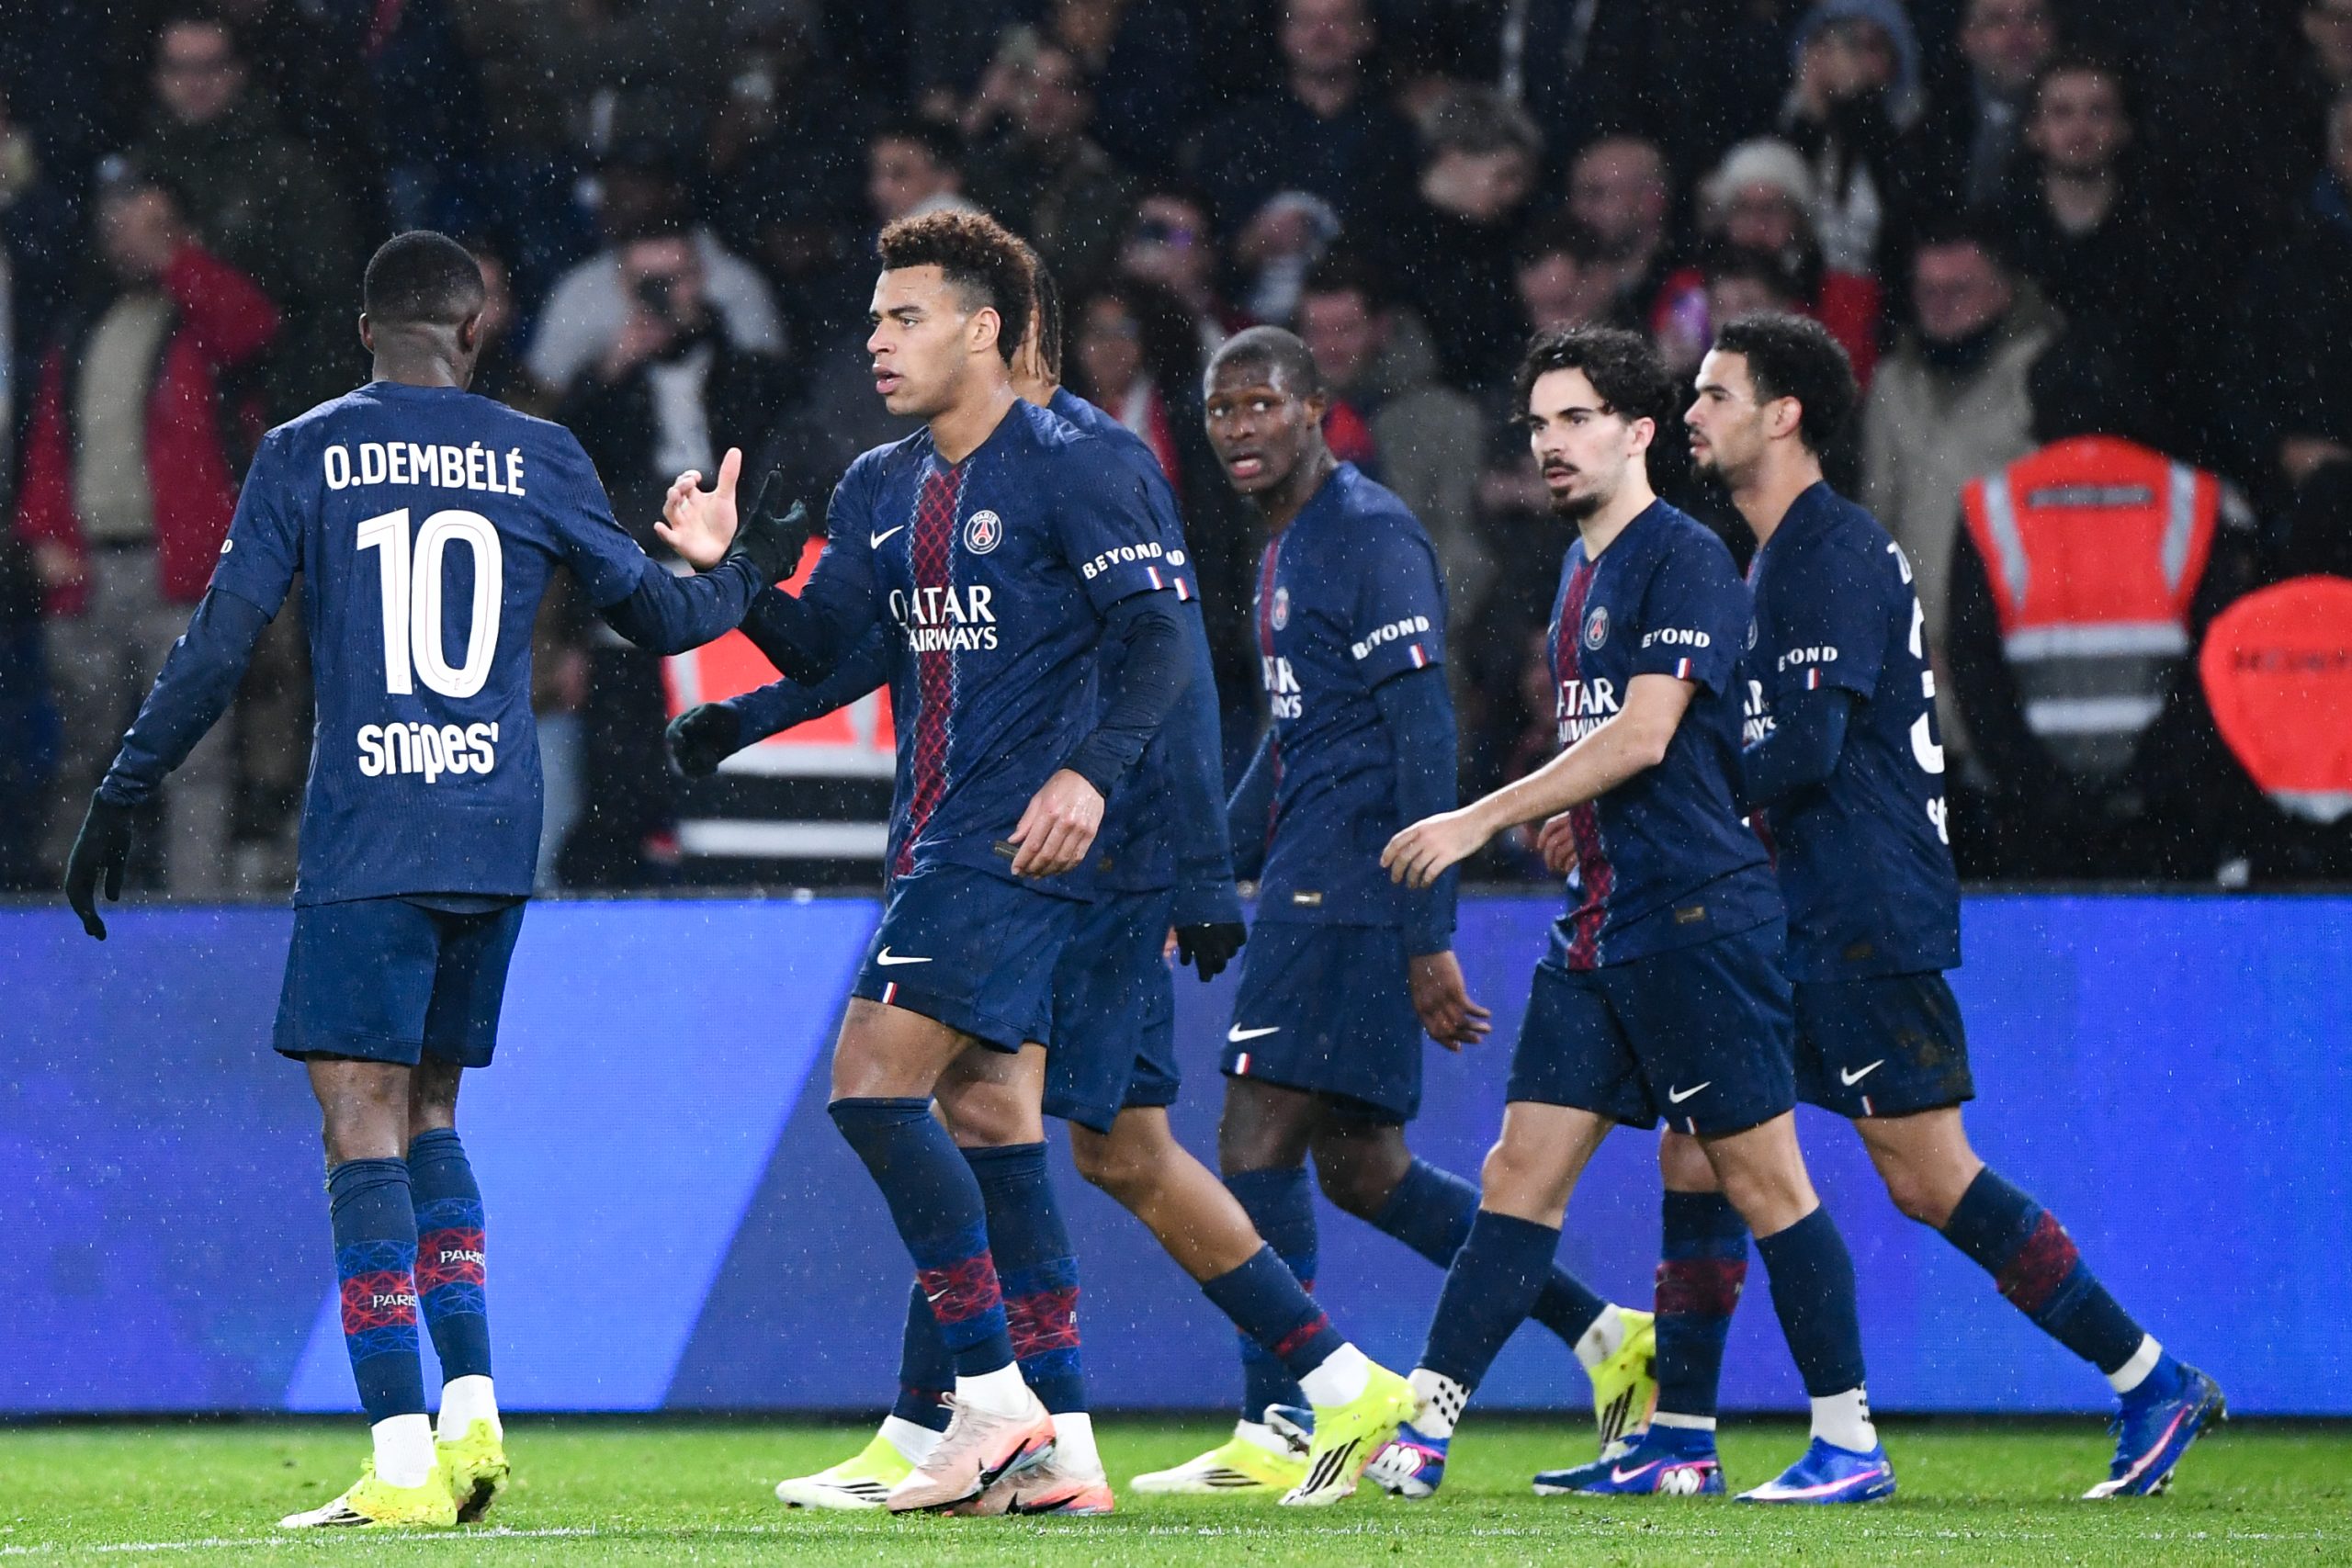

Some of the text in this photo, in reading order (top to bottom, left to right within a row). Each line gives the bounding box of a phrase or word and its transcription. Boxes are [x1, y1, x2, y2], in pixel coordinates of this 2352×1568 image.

[324, 441, 526, 496] O.DEMBÉLÉ
[1082, 541, 1162, 580] BEYOND
[356, 507, 503, 699] 10
[888, 585, 997, 634] QATAR
[909, 626, 998, 652] AIRWAYS
[1641, 627, 1711, 649] EYOND
[1556, 677, 1620, 718] ATAR
